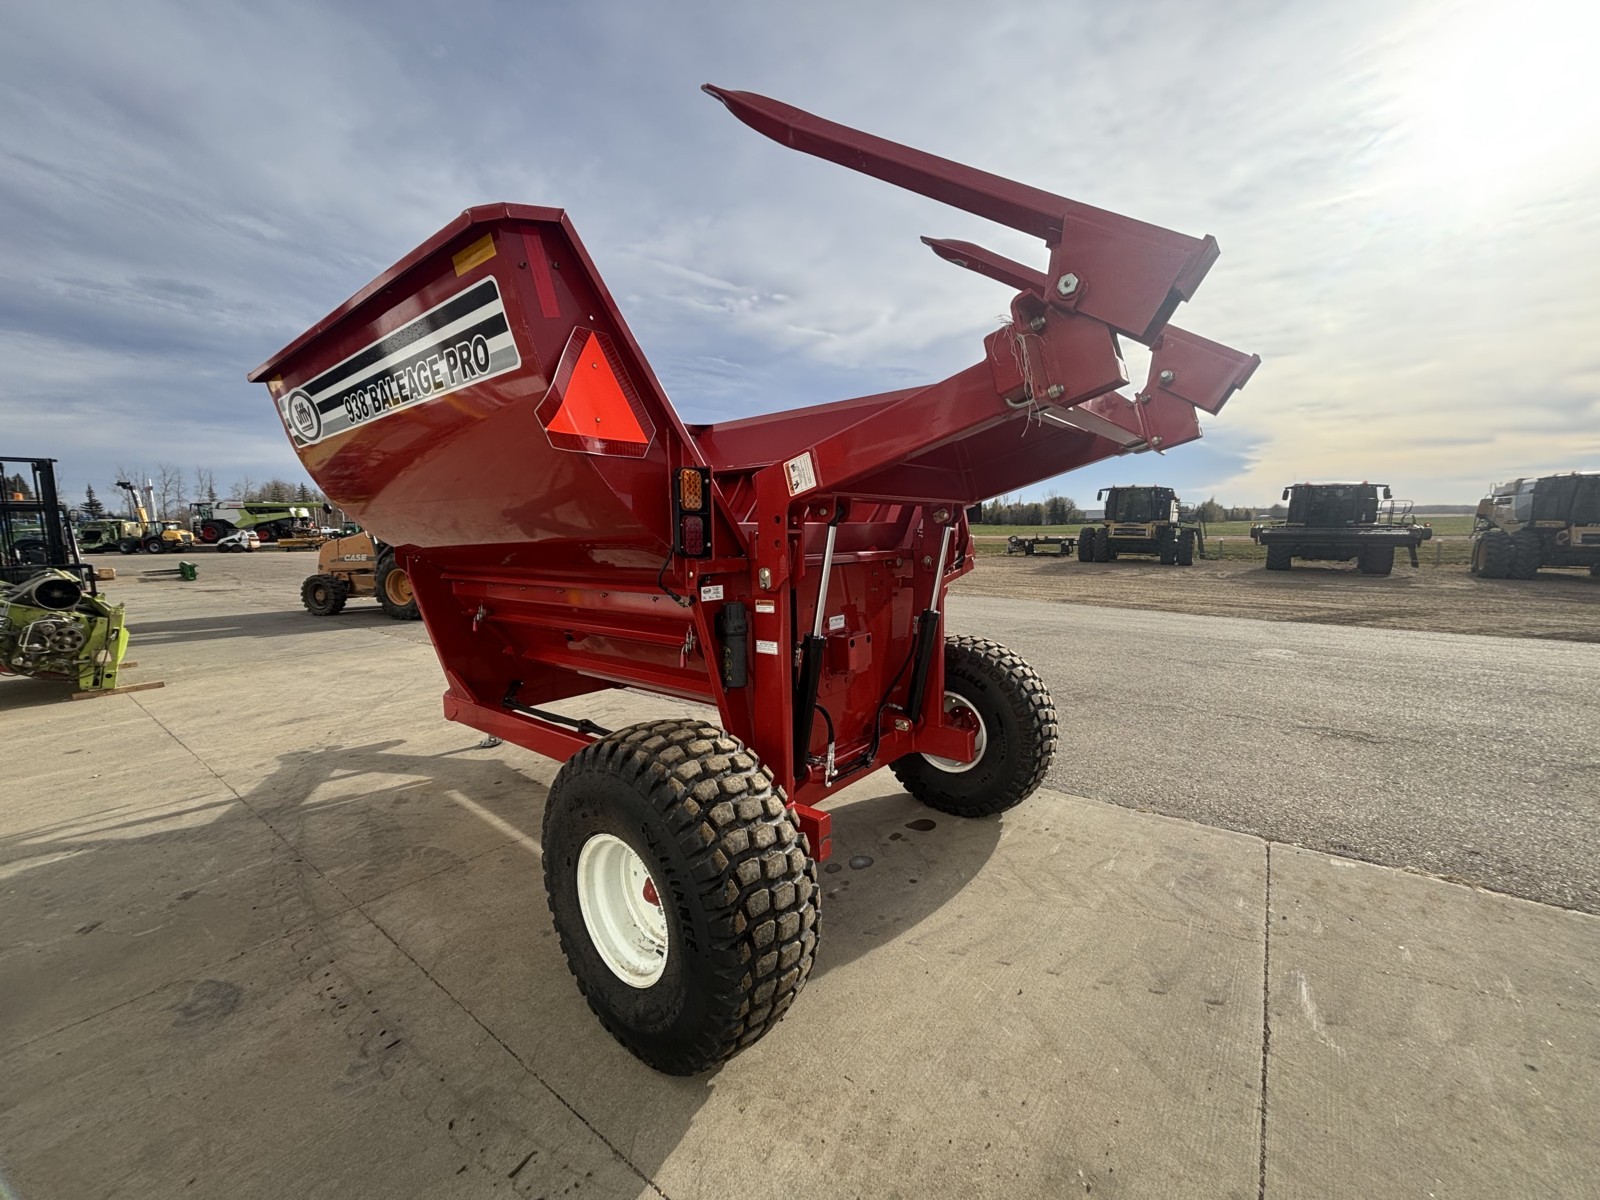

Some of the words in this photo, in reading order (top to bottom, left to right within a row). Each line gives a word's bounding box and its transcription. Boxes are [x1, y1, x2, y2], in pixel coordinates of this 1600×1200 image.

[344, 390, 370, 423] 938
[368, 355, 444, 414] BALEAGE
[444, 335, 490, 384] PRO
[344, 553, 367, 562] CASE
